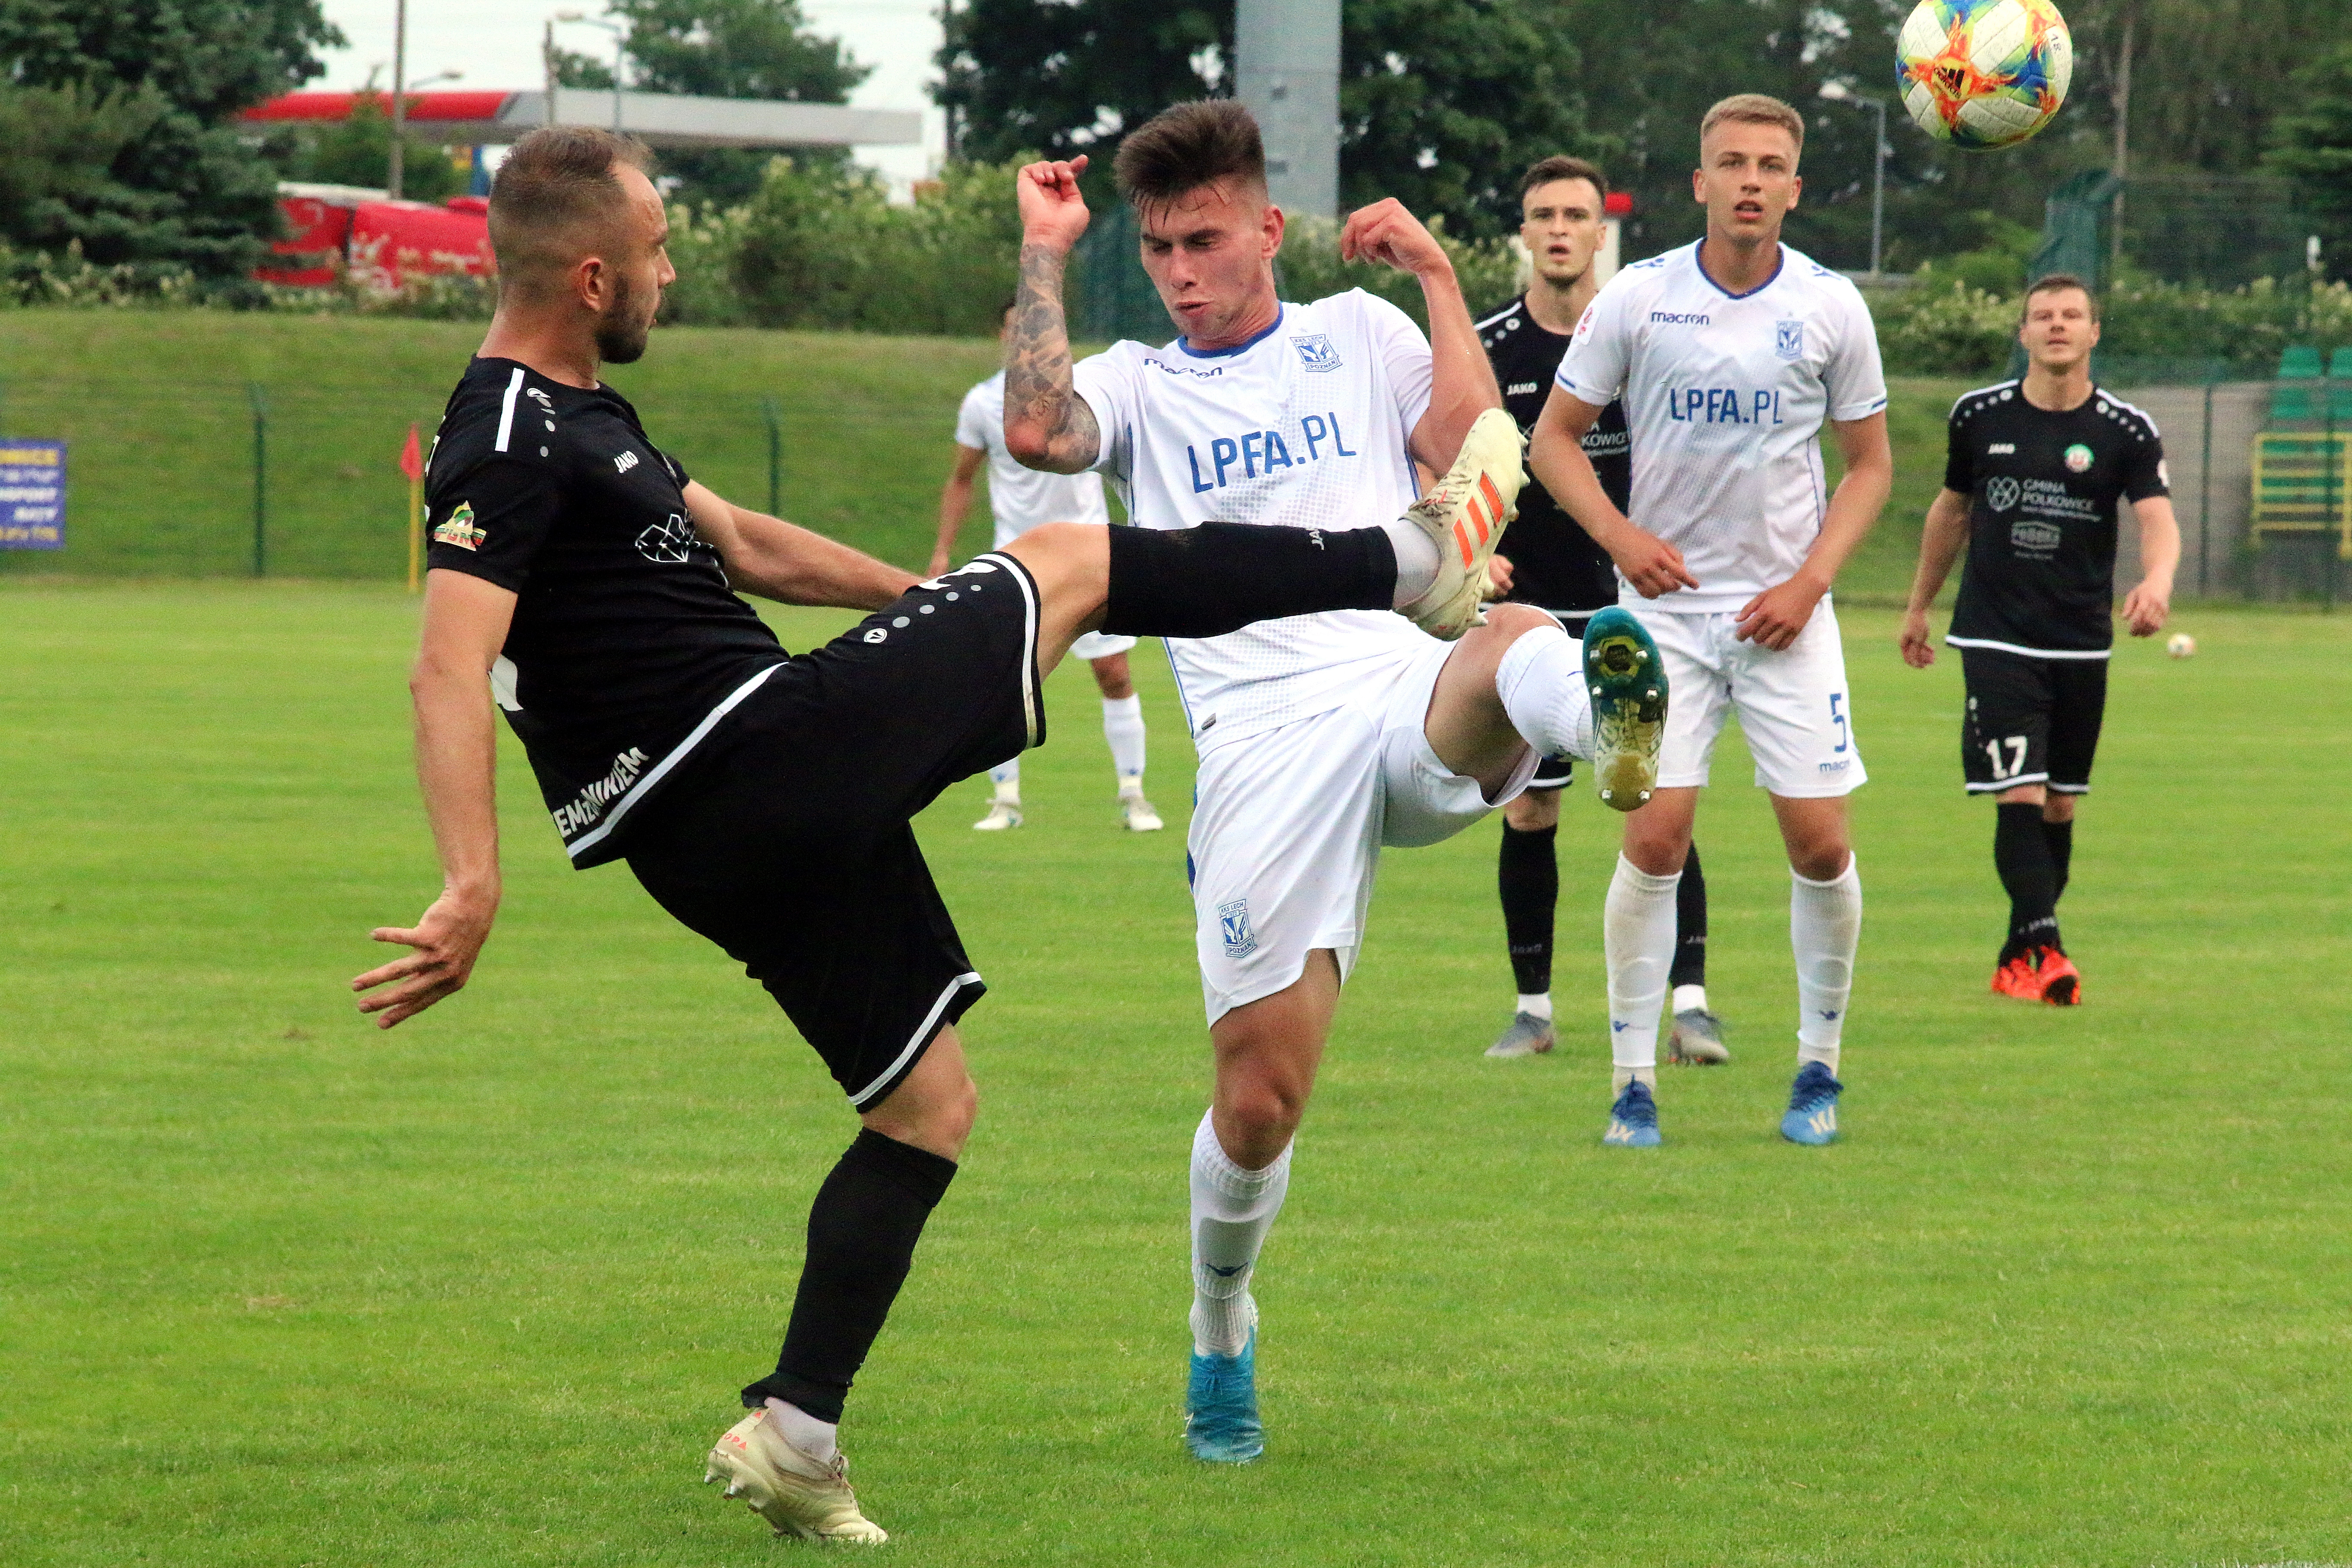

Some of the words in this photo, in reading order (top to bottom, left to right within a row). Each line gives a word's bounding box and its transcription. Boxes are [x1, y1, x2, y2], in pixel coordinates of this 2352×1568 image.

[1651, 312, 1709, 325] macron
[1507, 382, 1537, 395] JAKO
[1670, 389, 1783, 424] LPFA.PL
[614, 450, 639, 473] JAKO
[1187, 412, 1357, 493] LPFA.PL
[1830, 693, 1847, 753] 5
[1986, 736, 2027, 779] 17
[722, 1433, 747, 1450] OPA
